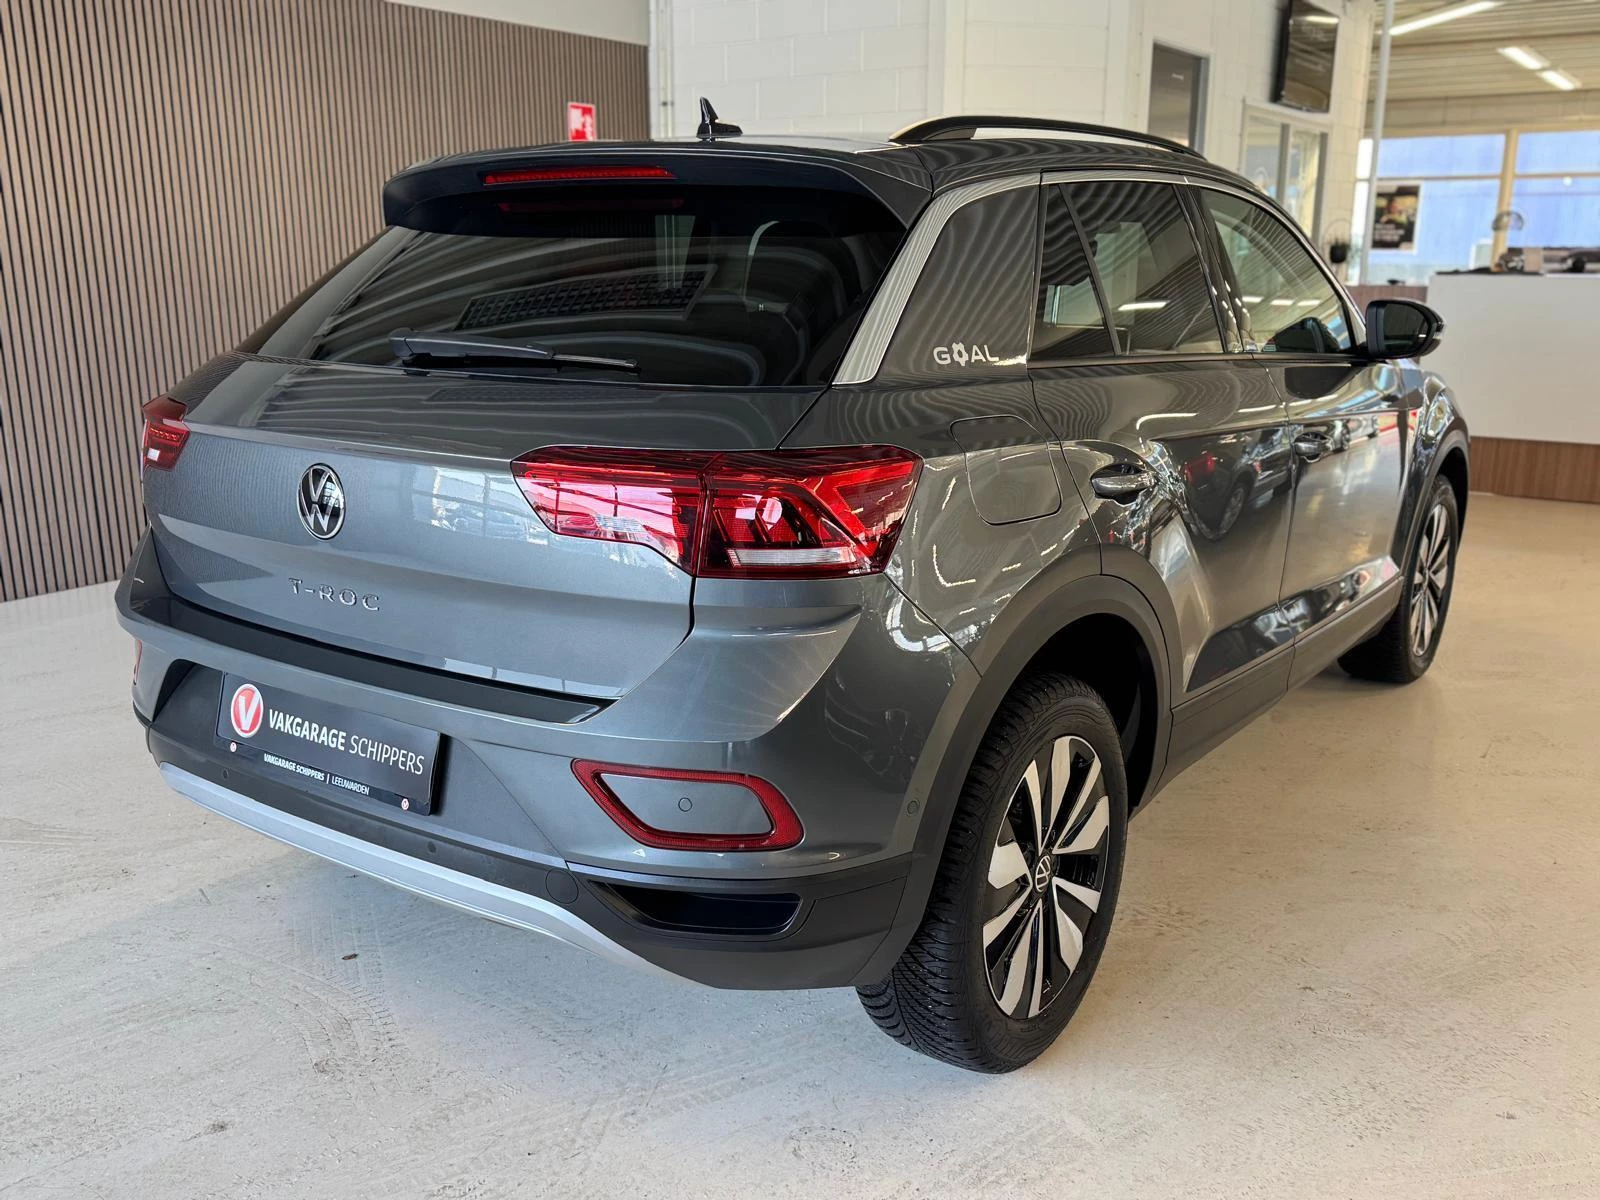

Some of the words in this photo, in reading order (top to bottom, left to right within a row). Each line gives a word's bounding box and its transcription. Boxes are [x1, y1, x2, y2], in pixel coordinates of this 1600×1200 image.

[933, 342, 999, 366] GOAL
[288, 577, 380, 611] T-ROC
[269, 708, 347, 751] VAKGARAGE
[349, 735, 425, 775] SCHIPPERS
[263, 753, 296, 771] VAKGARAGE
[296, 764, 325, 781] SCHIPPERS
[331, 775, 370, 795] LEEUWARDEN
